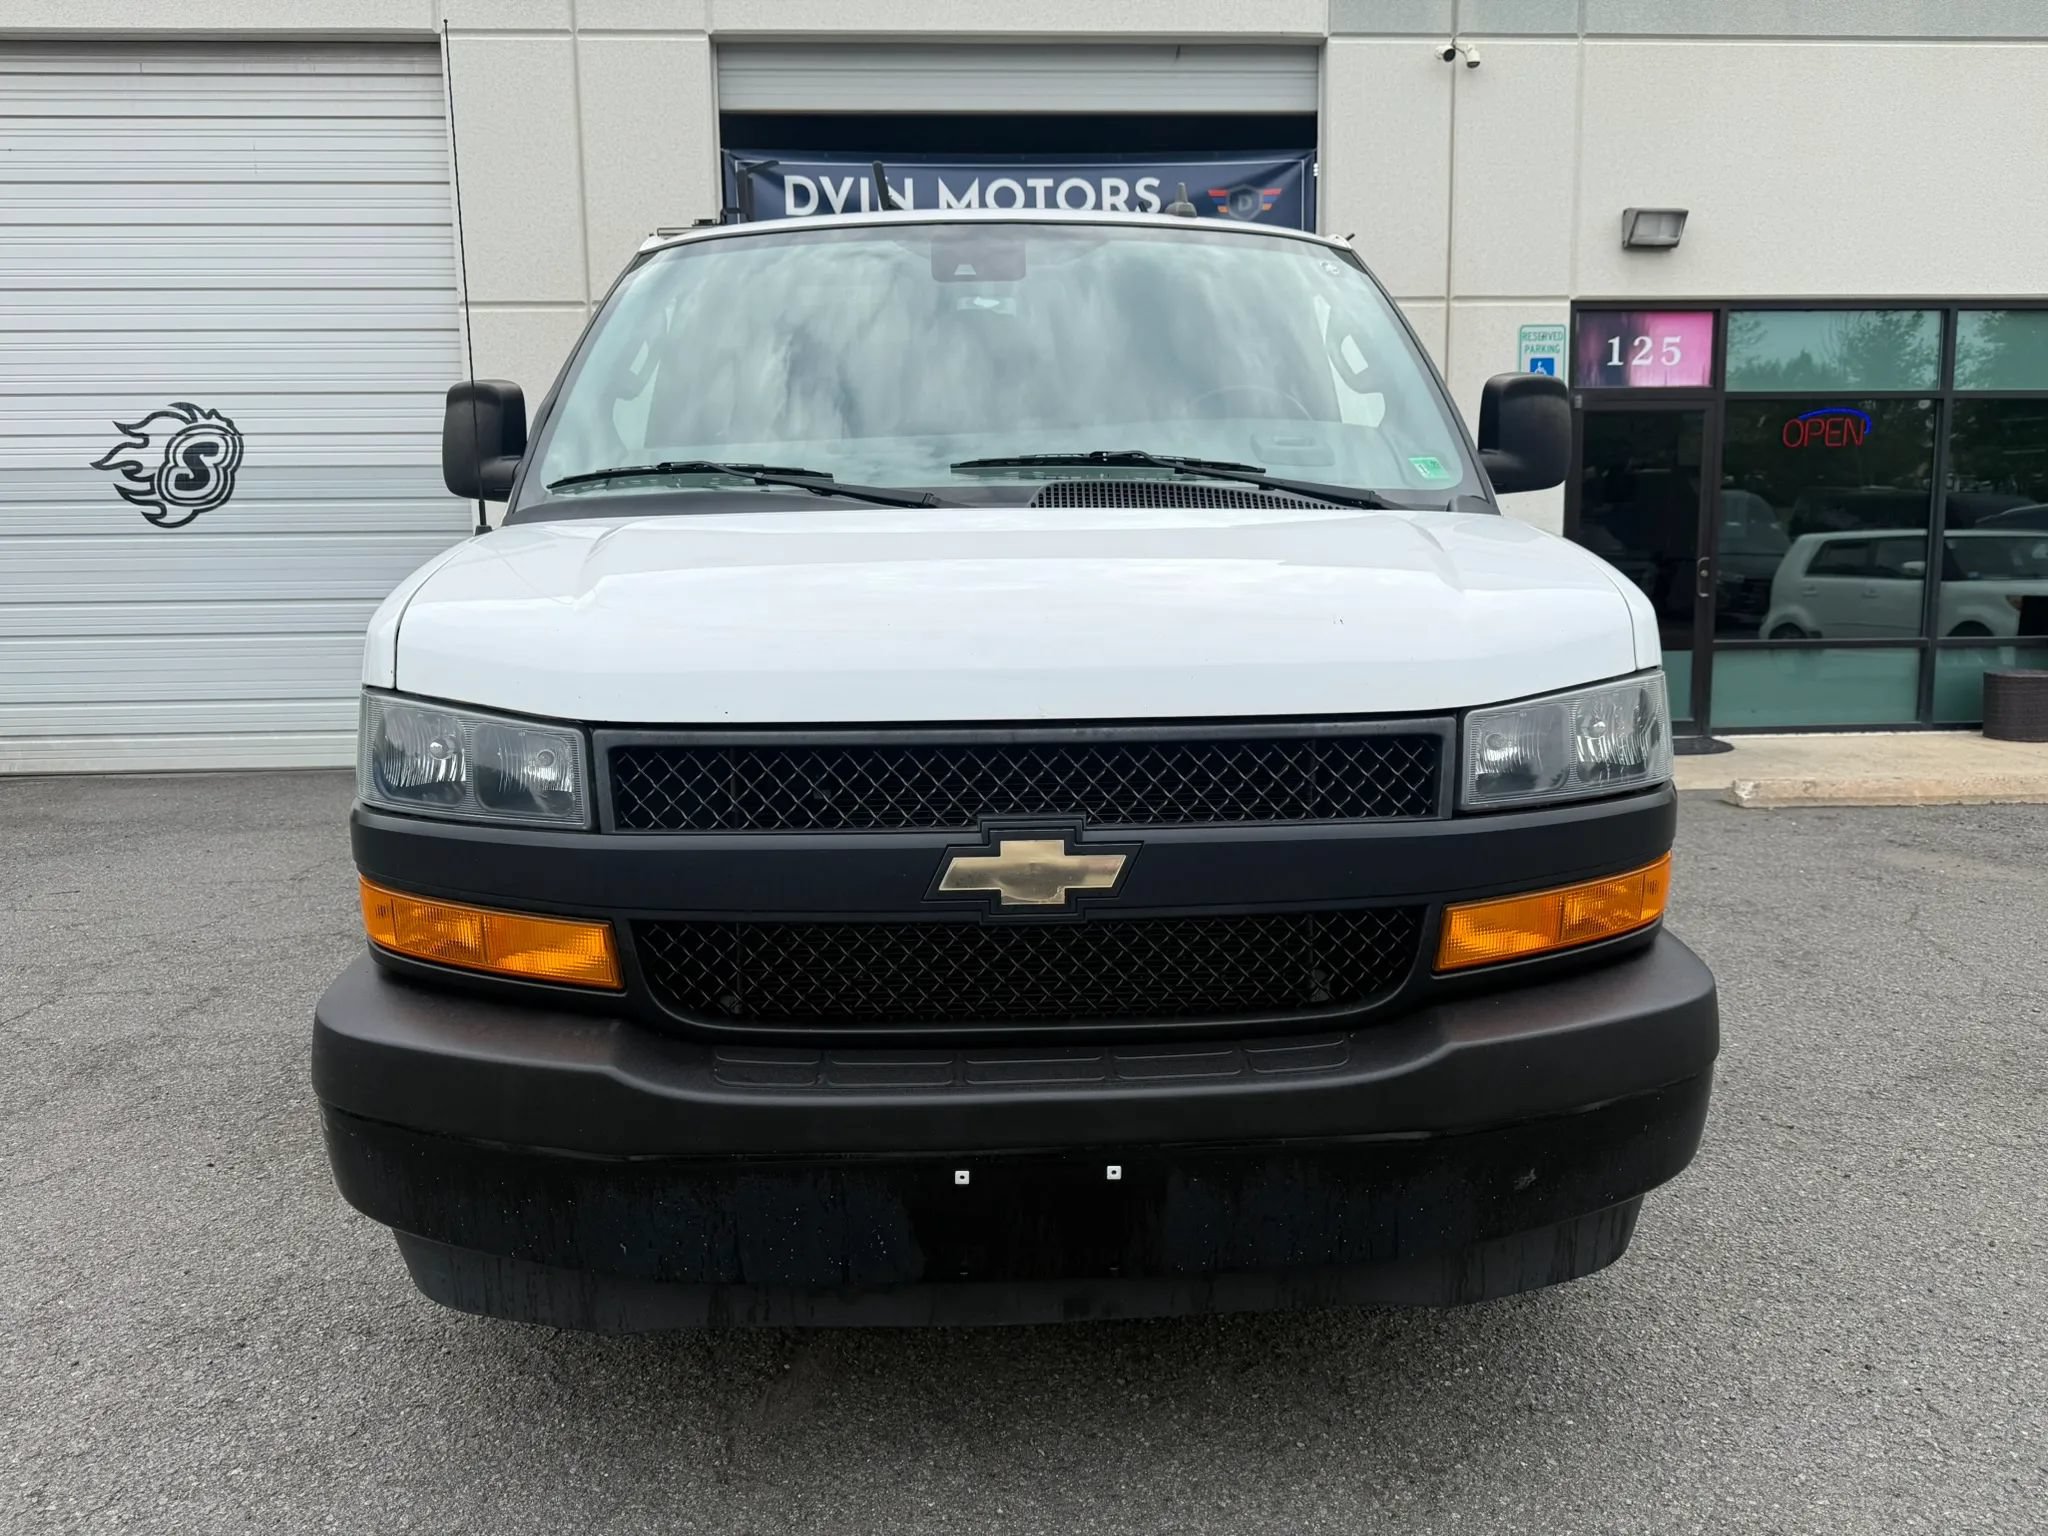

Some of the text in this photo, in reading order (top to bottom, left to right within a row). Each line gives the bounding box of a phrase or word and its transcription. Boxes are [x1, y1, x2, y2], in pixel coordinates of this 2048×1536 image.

[938, 177, 1161, 214] MOTORS
[1522, 331, 1563, 342] RESERVED
[1524, 343, 1561, 354] PARKING
[1606, 335, 1683, 367] 125
[1783, 417, 1865, 448] OPEN
